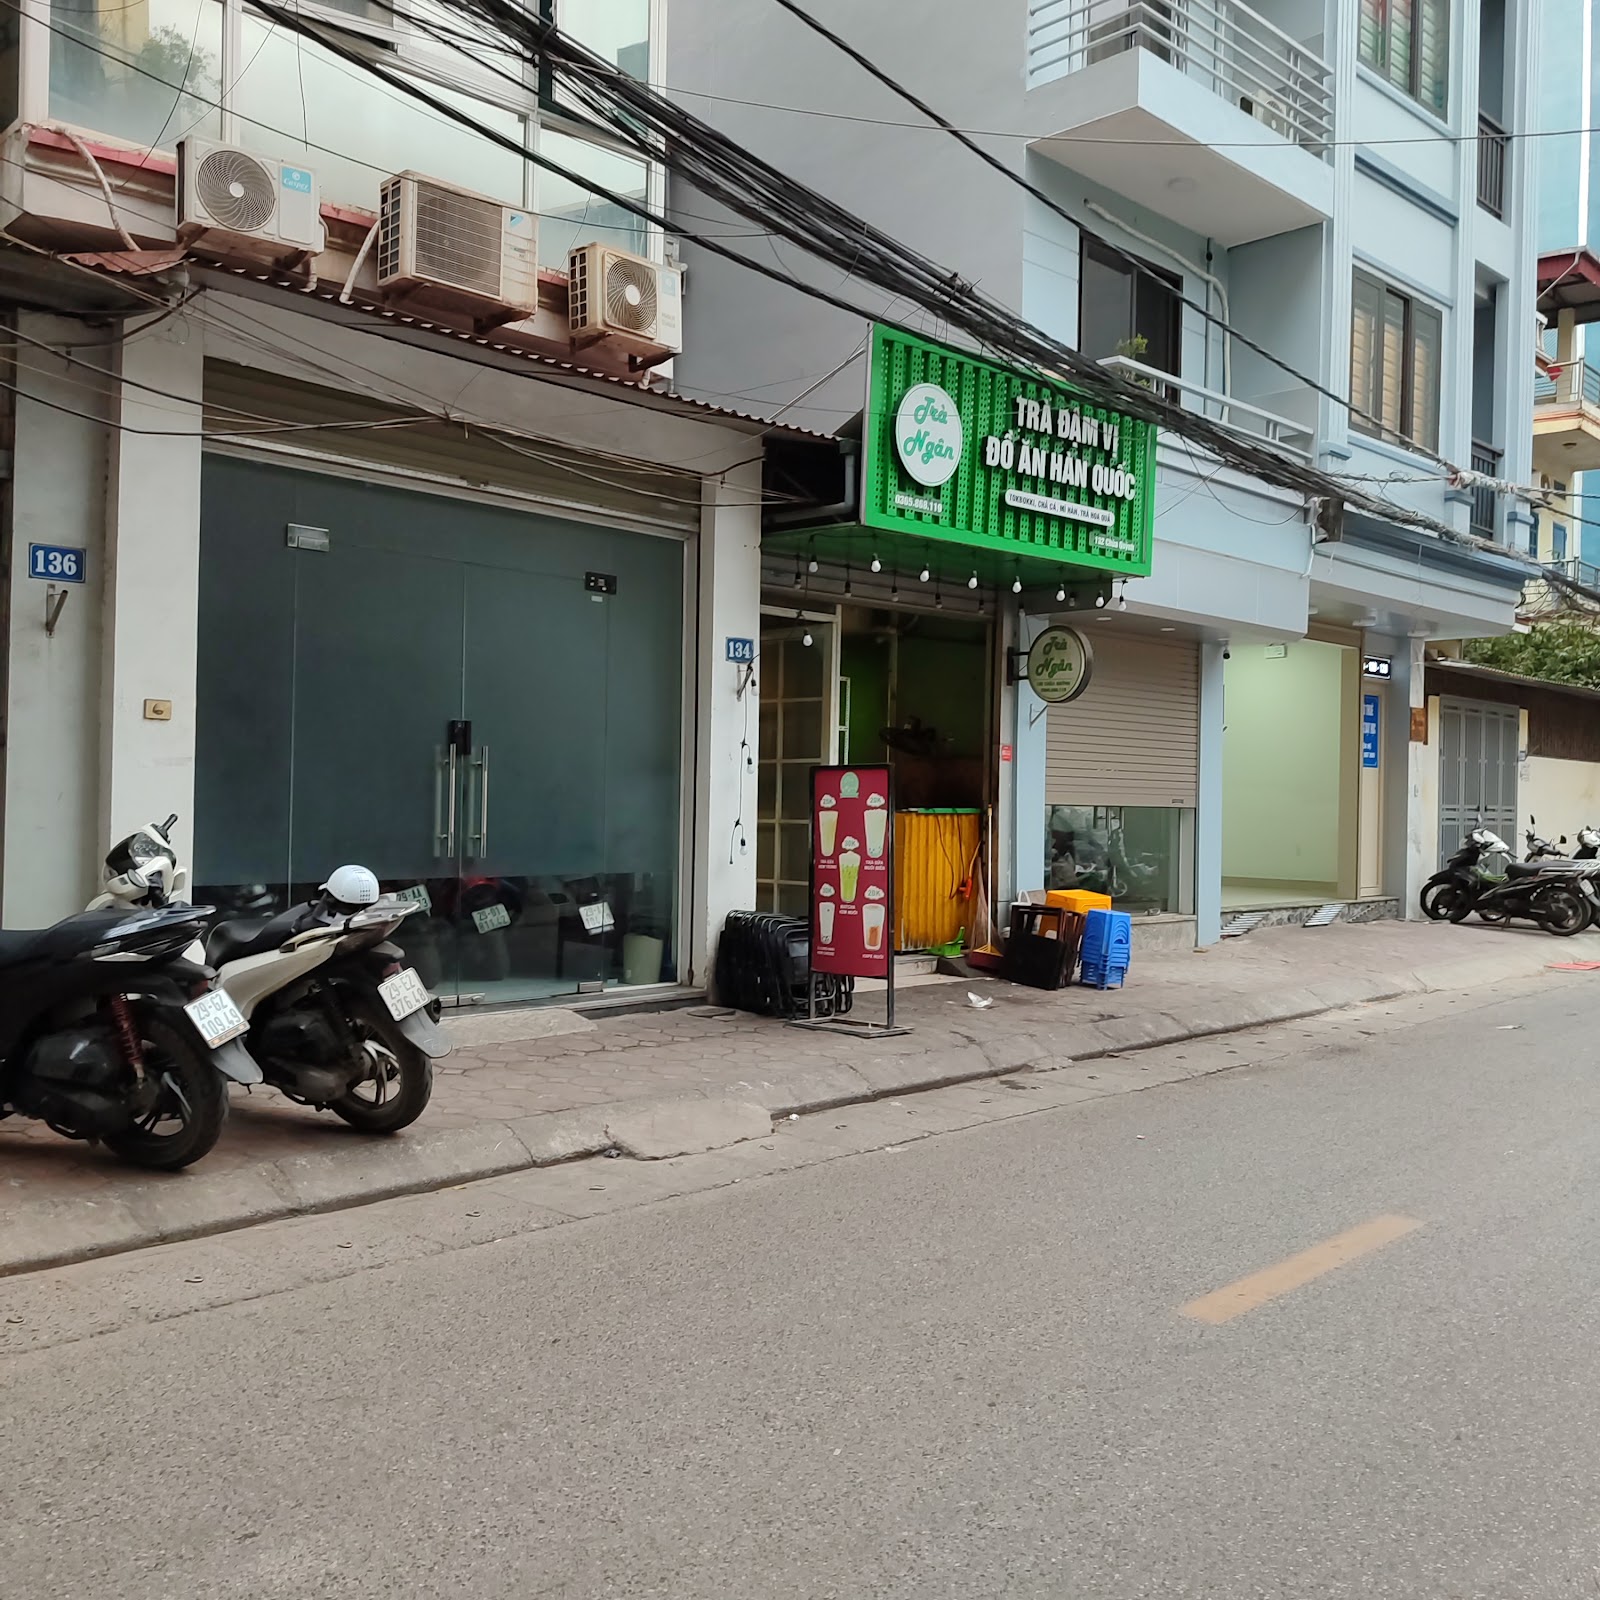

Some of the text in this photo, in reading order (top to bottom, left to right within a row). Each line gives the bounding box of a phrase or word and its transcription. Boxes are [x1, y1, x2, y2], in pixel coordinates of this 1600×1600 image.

[913, 396, 948, 425] Trà
[1016, 394, 1120, 458] TRÀ ĐẬM VỊ
[903, 429, 954, 464] Ngân
[986, 429, 1137, 500] ĐỒ ĂN HÀN QUỐC
[35, 549, 77, 576] 136
[728, 641, 751, 659] 134
[1043, 636, 1068, 656] Trà
[1035, 658, 1073, 678] Ngân
[385, 974, 416, 1000] 29-E2
[193, 993, 228, 1022] 29-G2
[391, 988, 426, 1017] 376.48
[201, 1008, 241, 1038] 109.49
